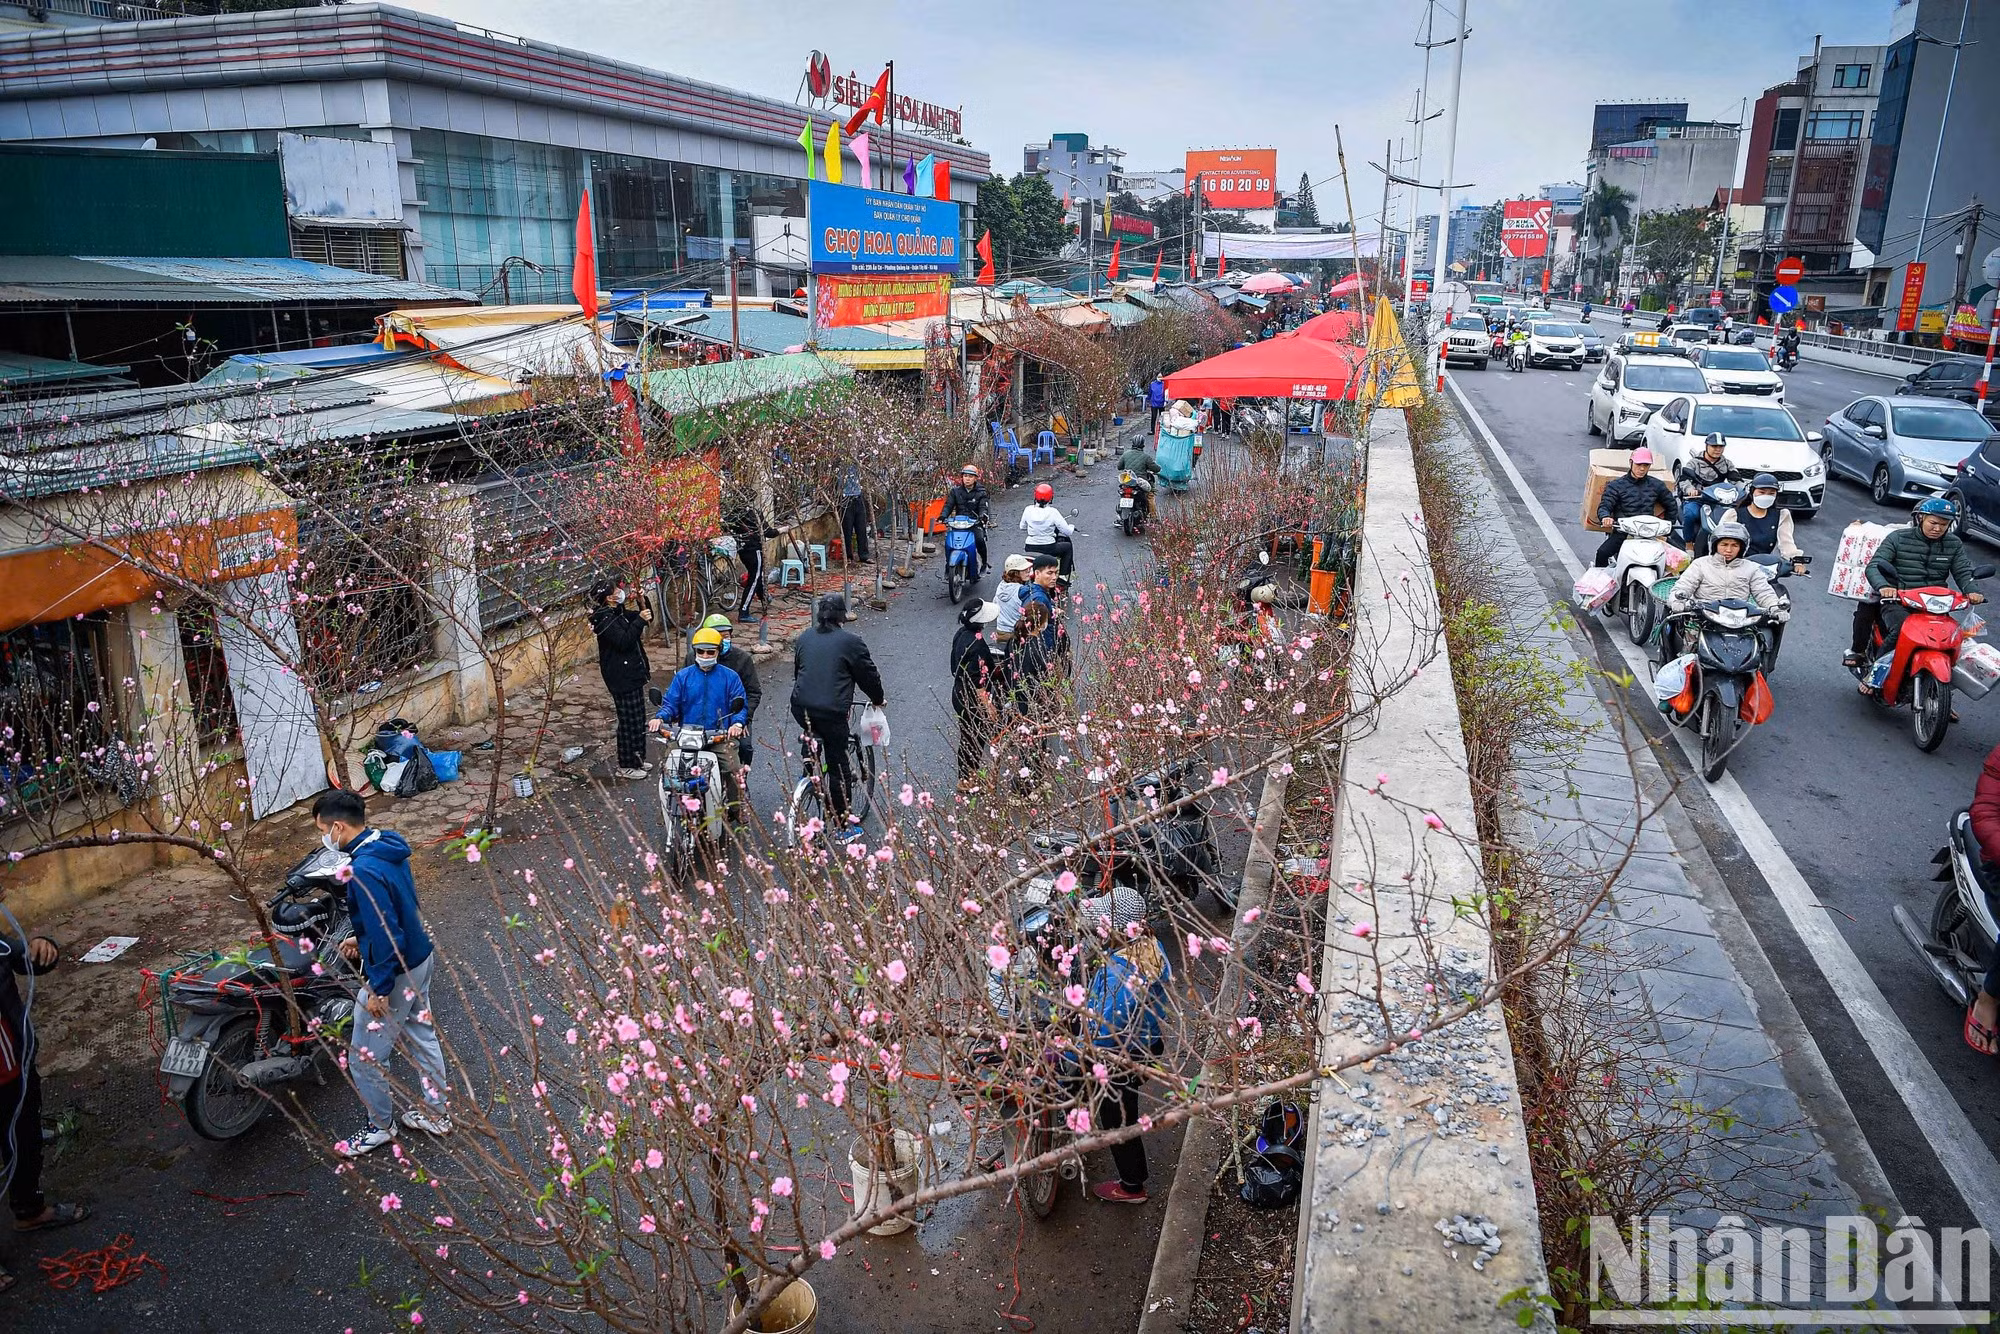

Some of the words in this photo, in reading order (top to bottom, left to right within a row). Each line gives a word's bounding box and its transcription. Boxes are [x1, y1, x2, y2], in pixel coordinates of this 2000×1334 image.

[1220, 178, 1234, 192] 80
[1237, 178, 1252, 192] 20
[1255, 178, 1270, 192] 99
[825, 227, 860, 259] CHỢ
[863, 230, 894, 255] HOA
[897, 227, 937, 257] QUẢNG
[940, 236, 954, 256] AN
